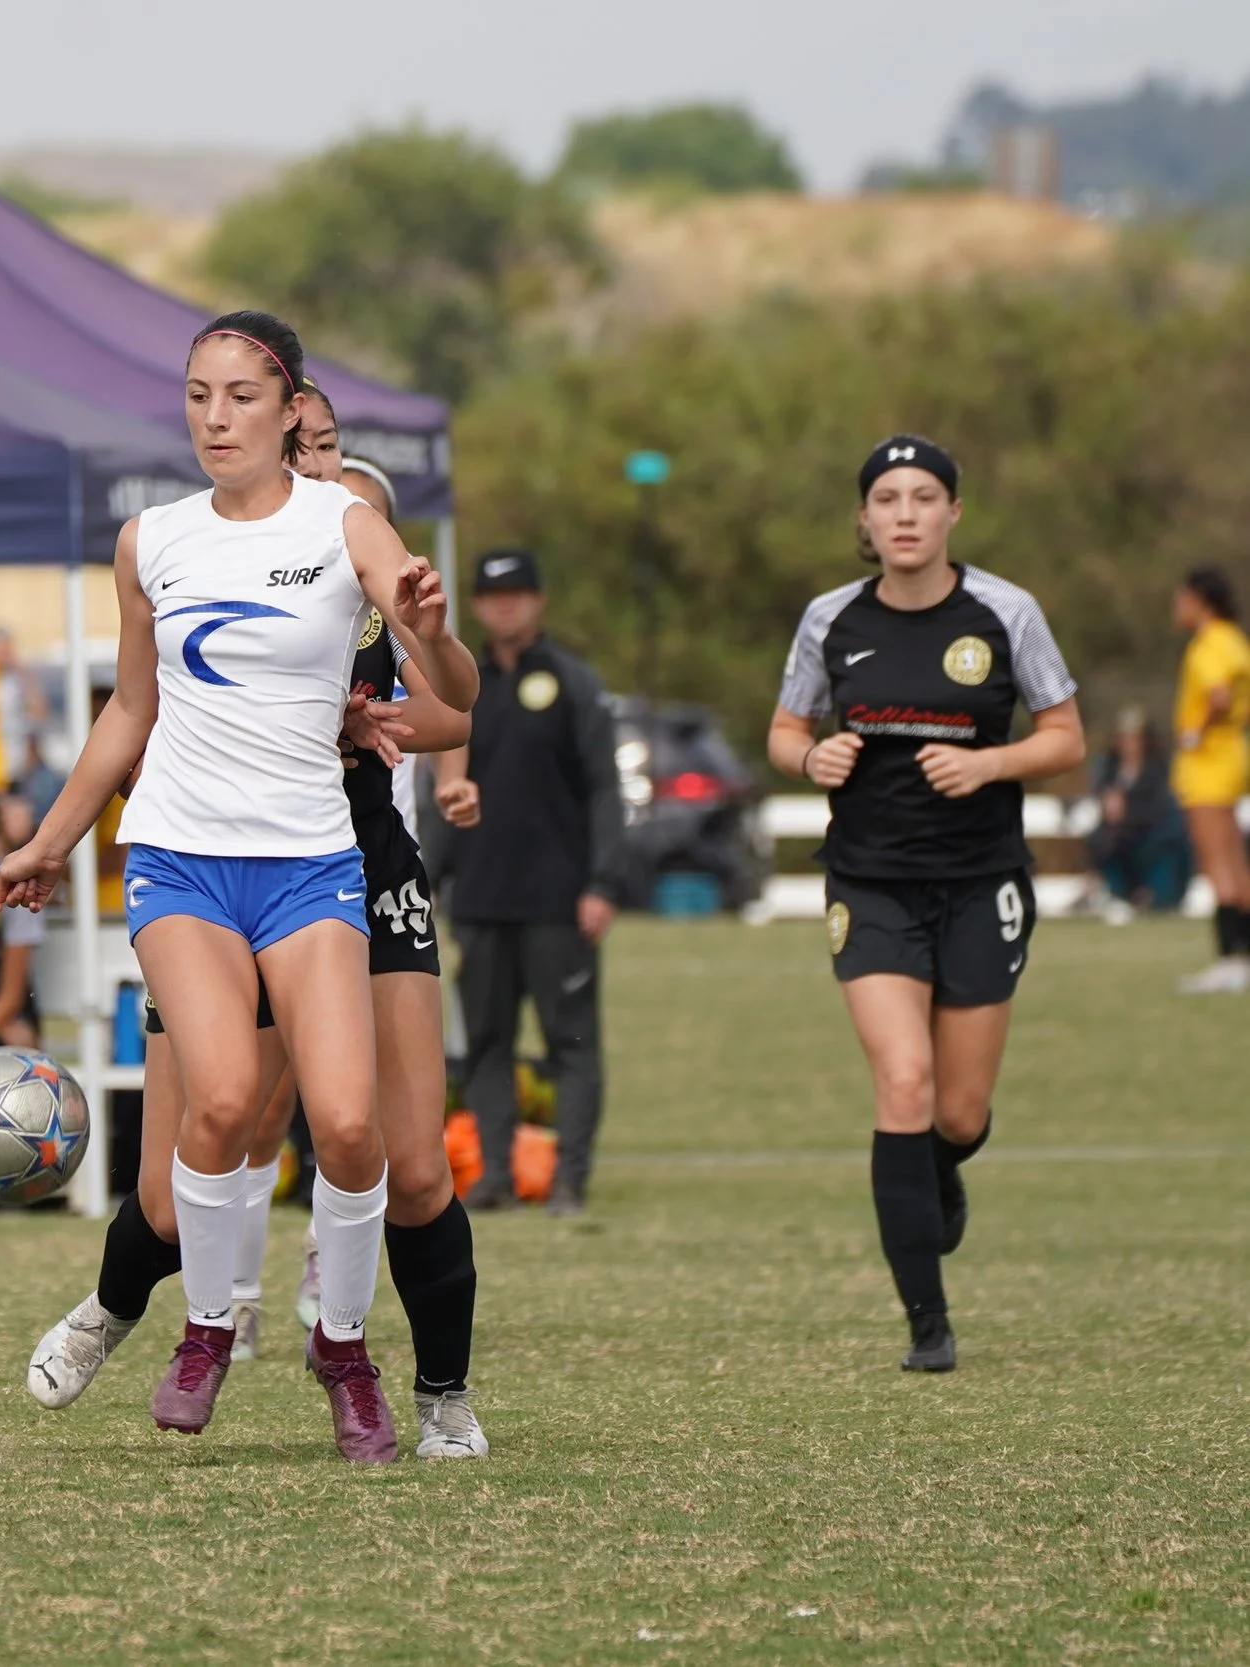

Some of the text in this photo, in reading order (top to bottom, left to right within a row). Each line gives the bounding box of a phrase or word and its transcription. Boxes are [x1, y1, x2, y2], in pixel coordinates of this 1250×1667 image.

[266, 566, 324, 587] SURF
[368, 619, 381, 640] CLUB
[997, 881, 1024, 942] 9
